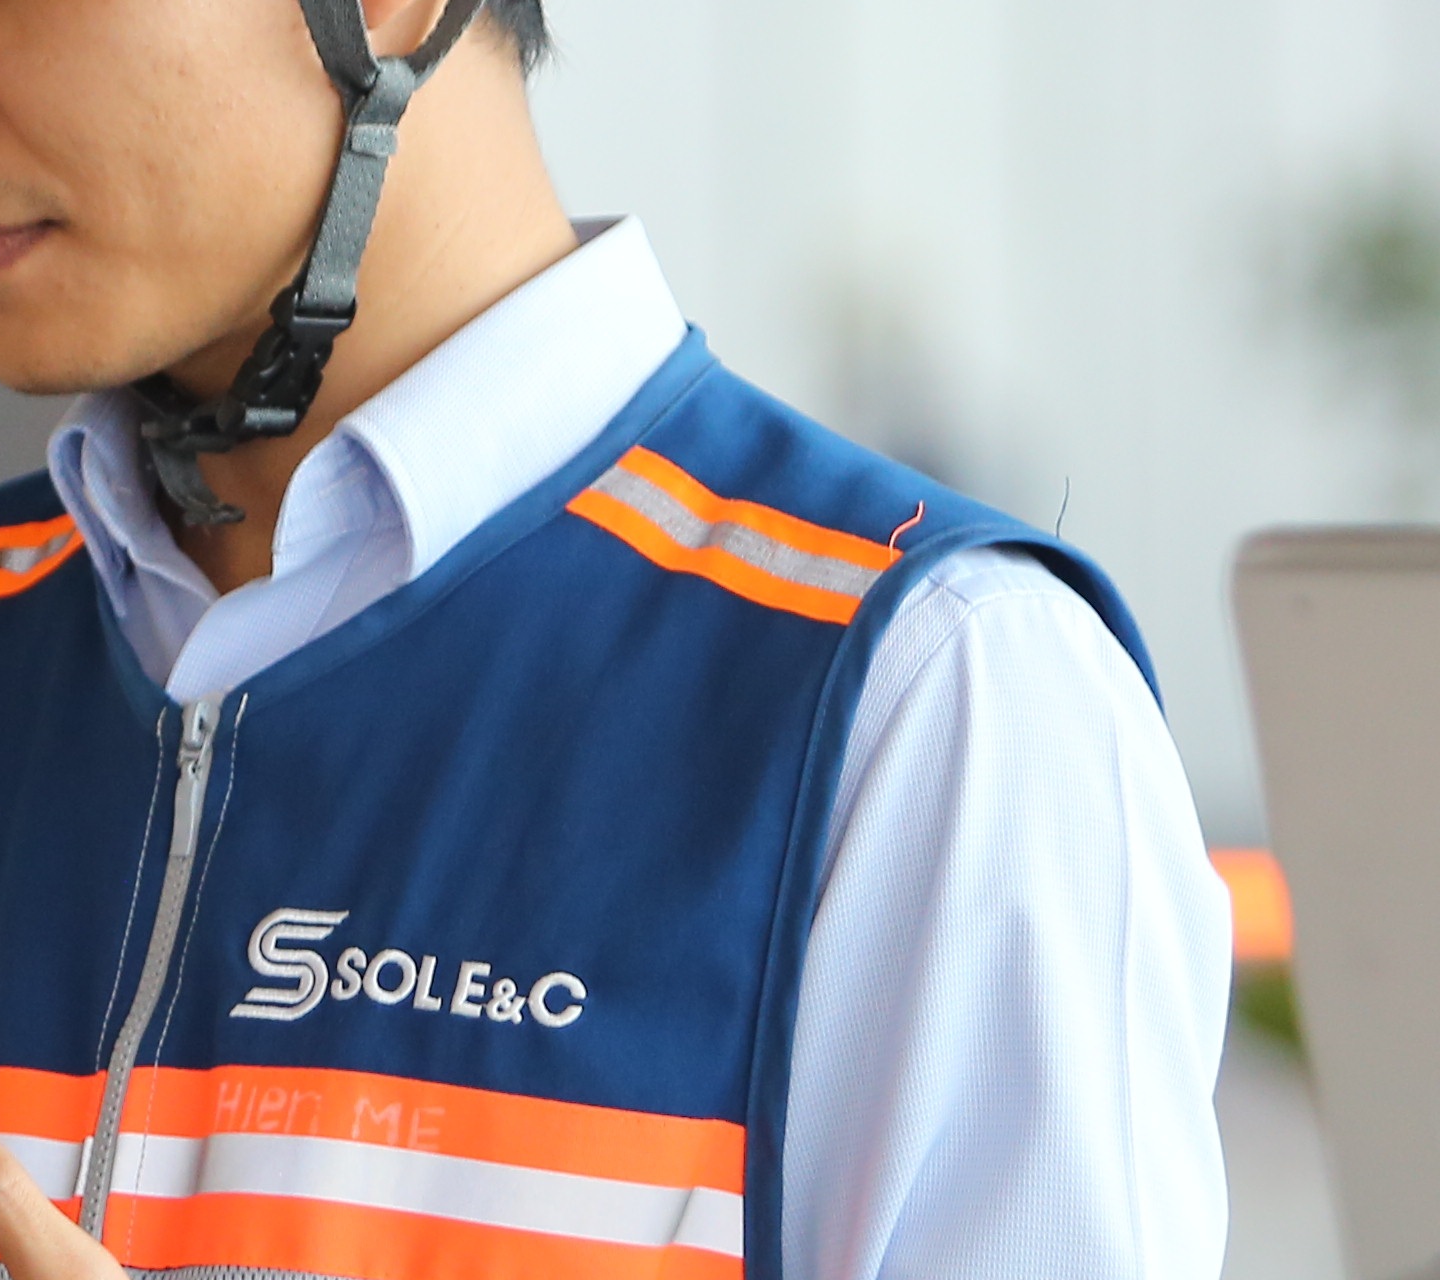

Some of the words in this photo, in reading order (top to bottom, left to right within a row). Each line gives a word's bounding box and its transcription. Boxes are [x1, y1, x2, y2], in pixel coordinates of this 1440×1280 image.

[330, 947, 442, 1011] SOL
[450, 961, 589, 1029] E&C
[351, 1097, 446, 1152] ME
